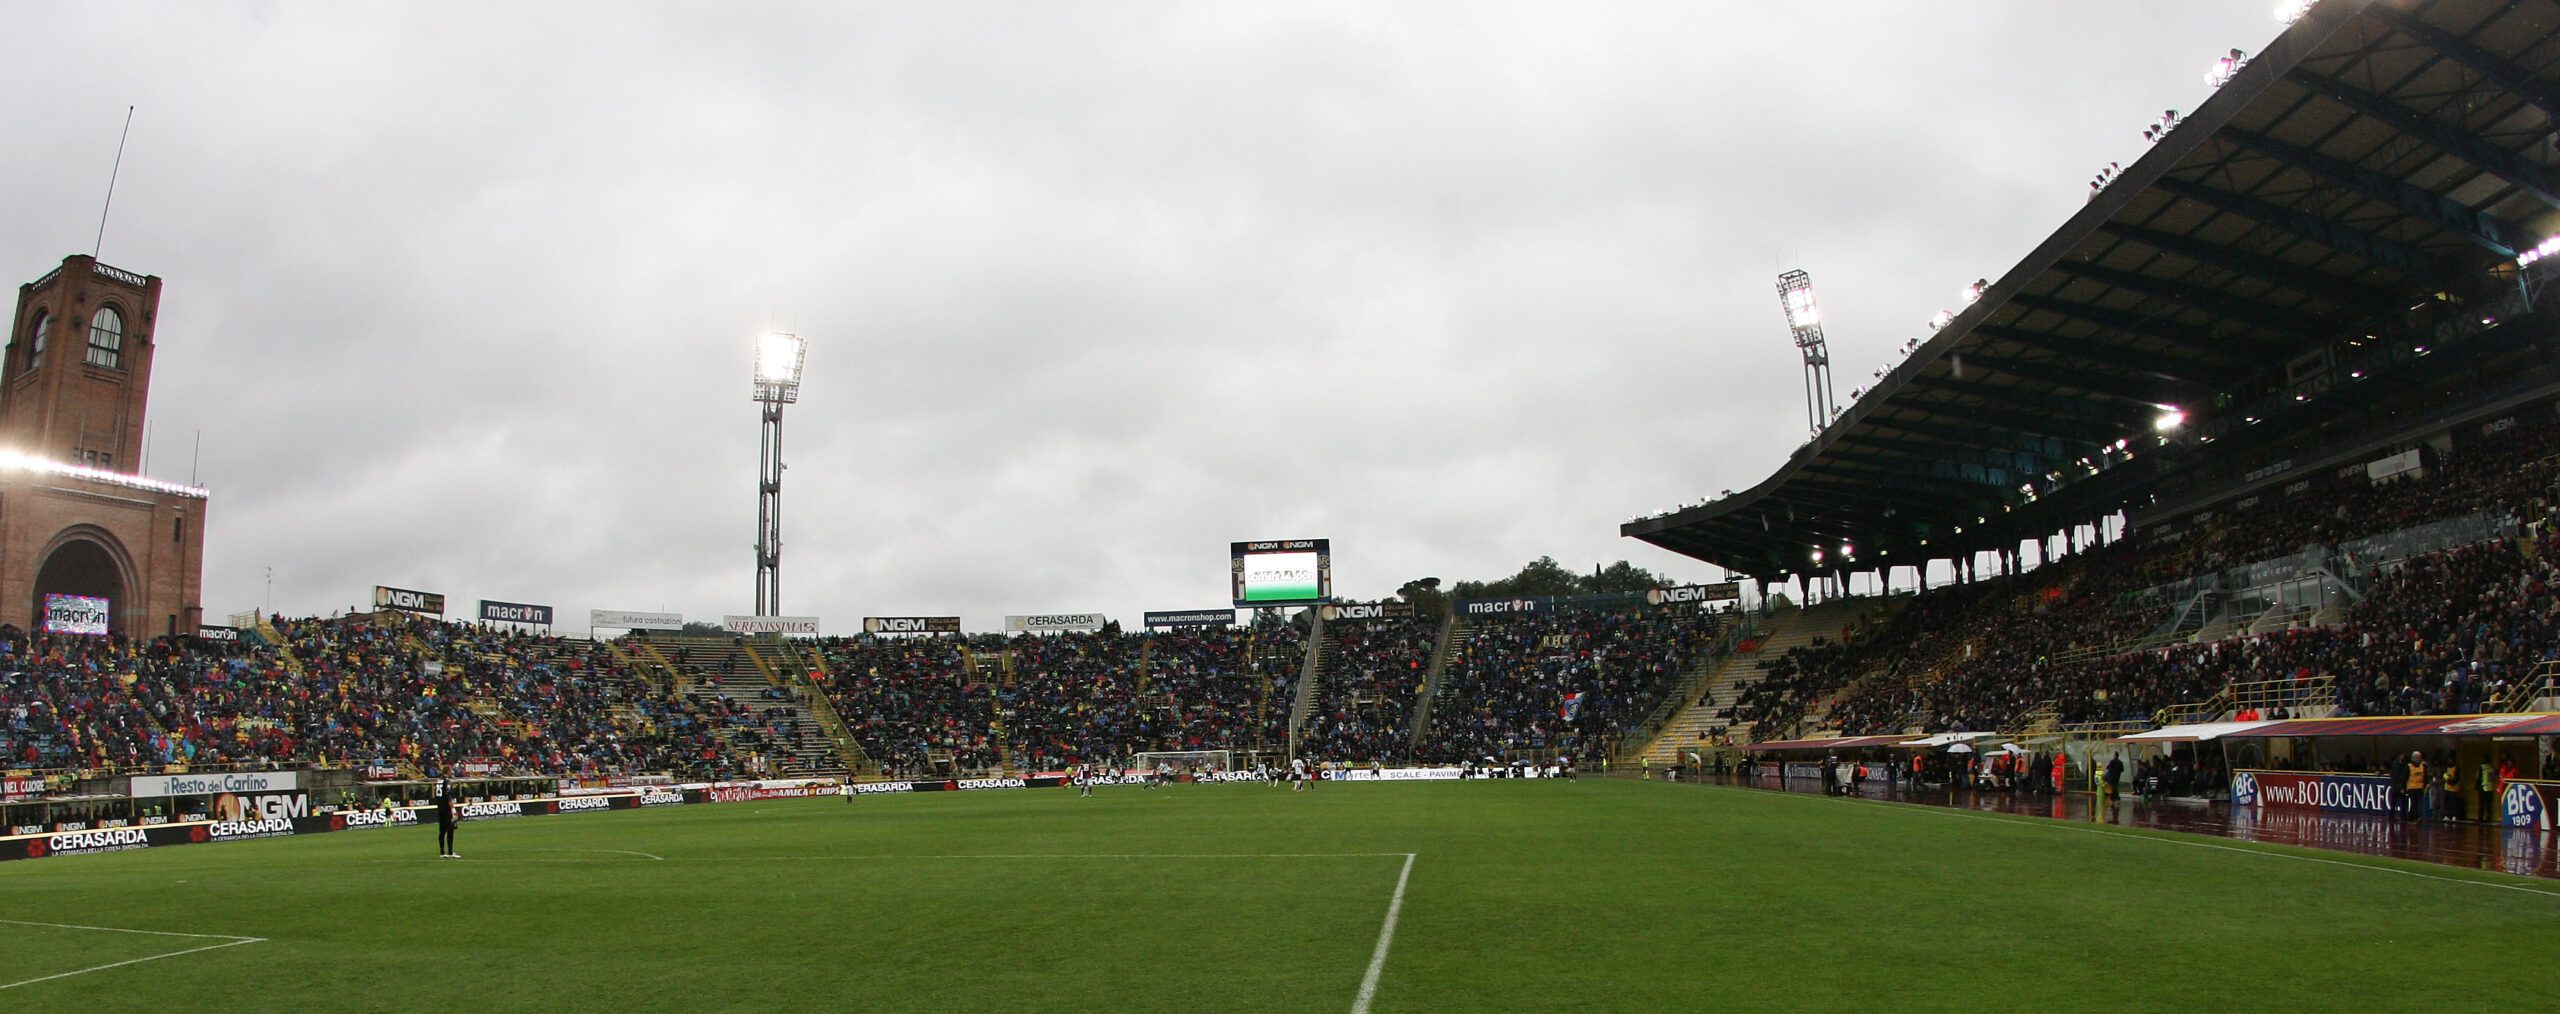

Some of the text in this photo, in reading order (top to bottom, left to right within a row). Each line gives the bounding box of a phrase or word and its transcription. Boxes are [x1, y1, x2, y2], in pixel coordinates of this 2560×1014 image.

[1254, 542, 1278, 550] NGM
[1289, 541, 1313, 549] NGM
[388, 591, 424, 609] NGM
[1660, 588, 1705, 603] NGM
[488, 605, 542, 621] macron
[1335, 604, 1383, 619] NGM
[1468, 599, 1534, 614] macron
[49, 607, 106, 625] macron
[1027, 615, 1094, 626] CERASARDA
[1147, 612, 1232, 624] www.macronshop.com
[728, 620, 804, 633] SERENISSIMA
[878, 618, 926, 631] NGM
[200, 629, 237, 641] macron
[1390, 770, 1421, 779] SCALE
[20, 779, 46, 793] CUORE
[171, 776, 205, 794] Resto
[208, 780, 222, 792] del
[224, 774, 268, 791] Carlino
[858, 781, 914, 793] ERASARDA
[957, 778, 1026, 790] CERASARDA
[2235, 772, 2254, 797] BFC
[777, 787, 809, 797] AMICA
[815, 785, 841, 796] CHIPS
[558, 798, 610, 811] CERASARDA
[640, 793, 684, 805] CERASARDA
[2506, 784, 2535, 816] BFC
[238, 793, 308, 822] NGM
[461, 802, 522, 817] CERASARDA
[146, 815, 168, 825] NGM
[185, 813, 206, 823] NGM
[2512, 814, 2531, 827] 1909
[19, 824, 43, 835] NGM
[62, 821, 86, 831] NGM
[209, 817, 294, 837] CERASARDA
[50, 829, 148, 851] CERASARDA
